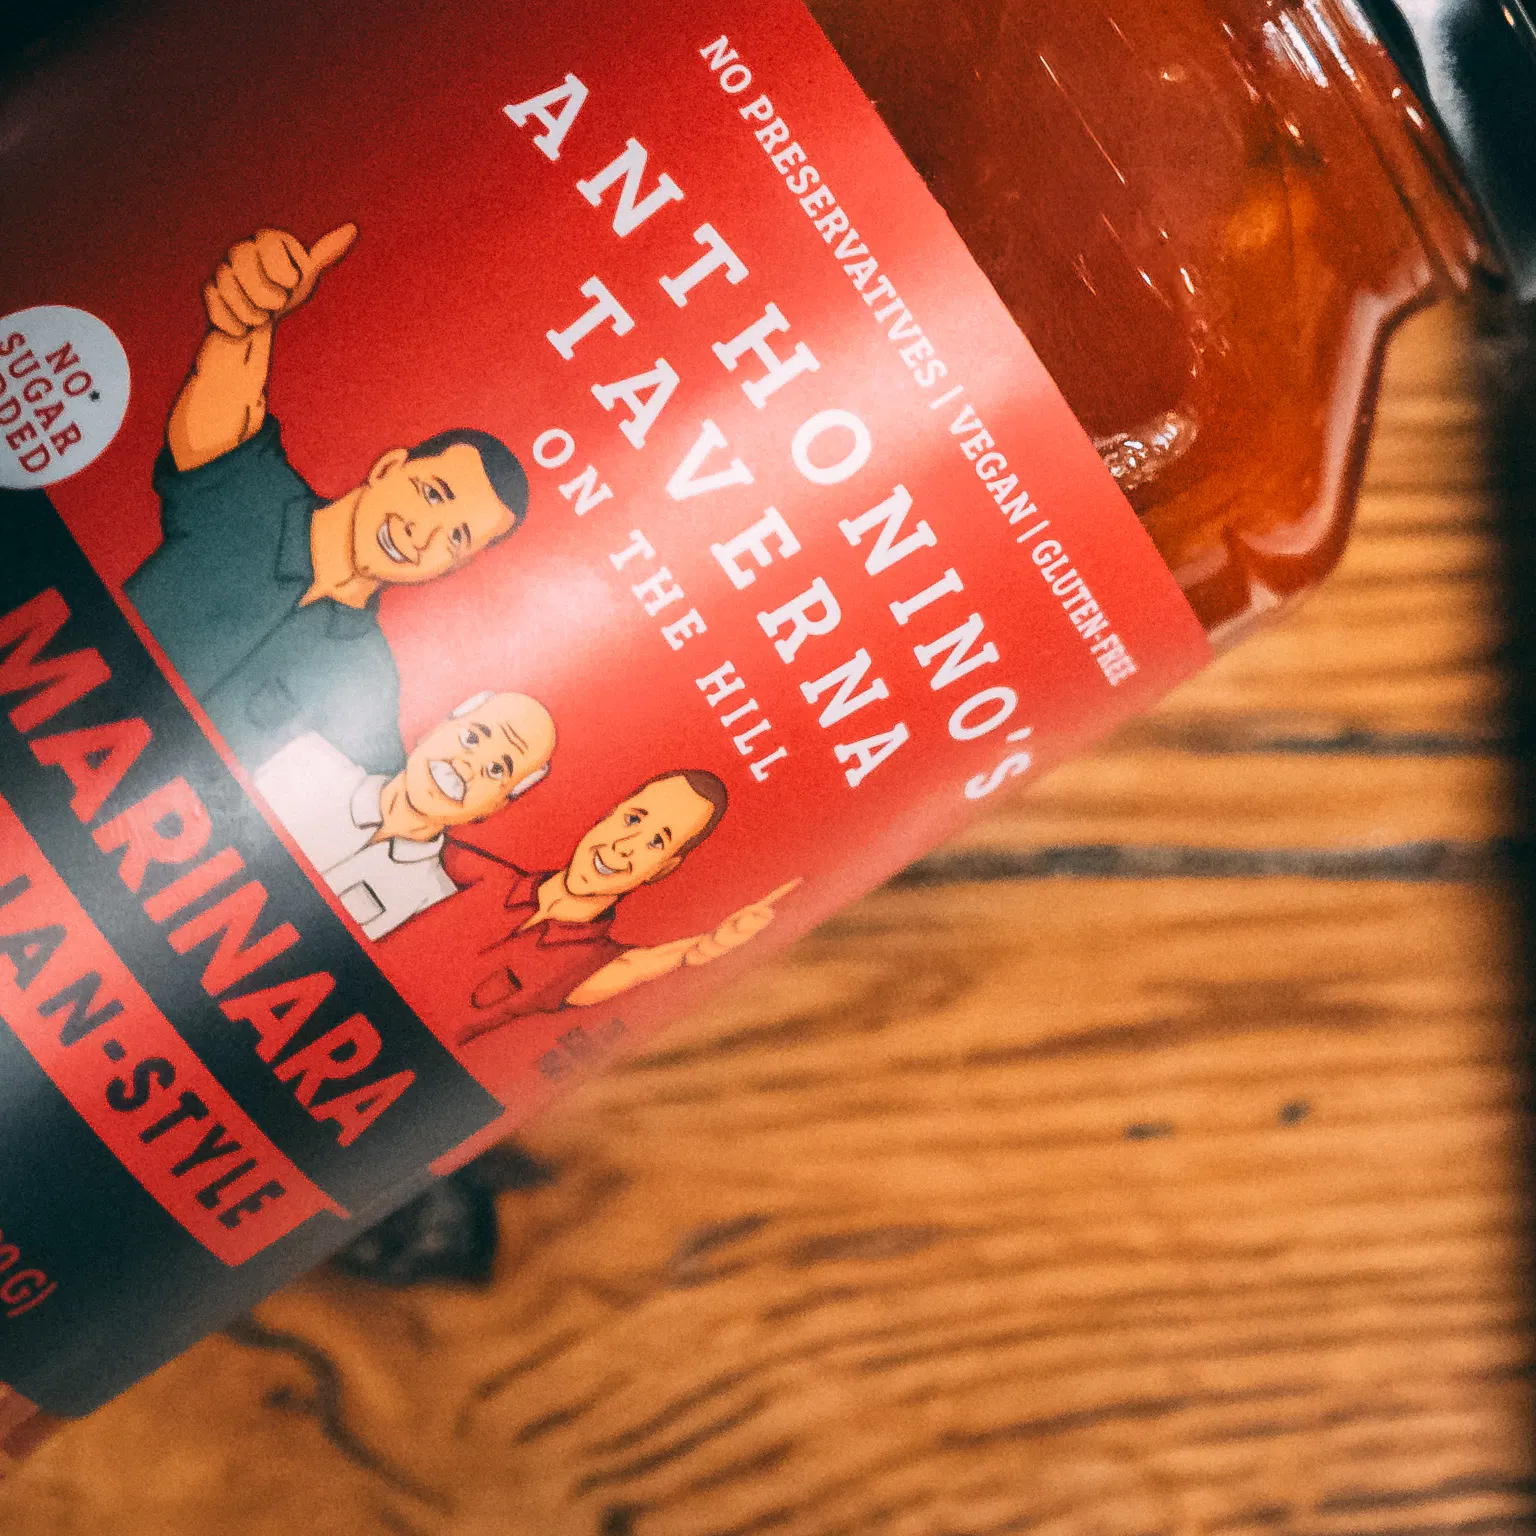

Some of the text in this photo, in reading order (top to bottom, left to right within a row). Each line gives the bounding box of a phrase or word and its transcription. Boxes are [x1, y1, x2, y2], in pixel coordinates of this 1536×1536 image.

[0, 331, 82, 457] SUGAR
[0, 372, 52, 474] DED
[503, 71, 1032, 801] ANTHONINO'S
[531, 426, 790, 784] ON THE HILL
[546, 275, 910, 789] TAVERNA
[699, 35, 752, 94] NO
[739, 94, 947, 388] PRESERVATIVES
[949, 404, 1038, 525] VEGAN
[1032, 539, 1140, 688] GLUTEN-FREE
[0, 586, 419, 1149] MARINARA
